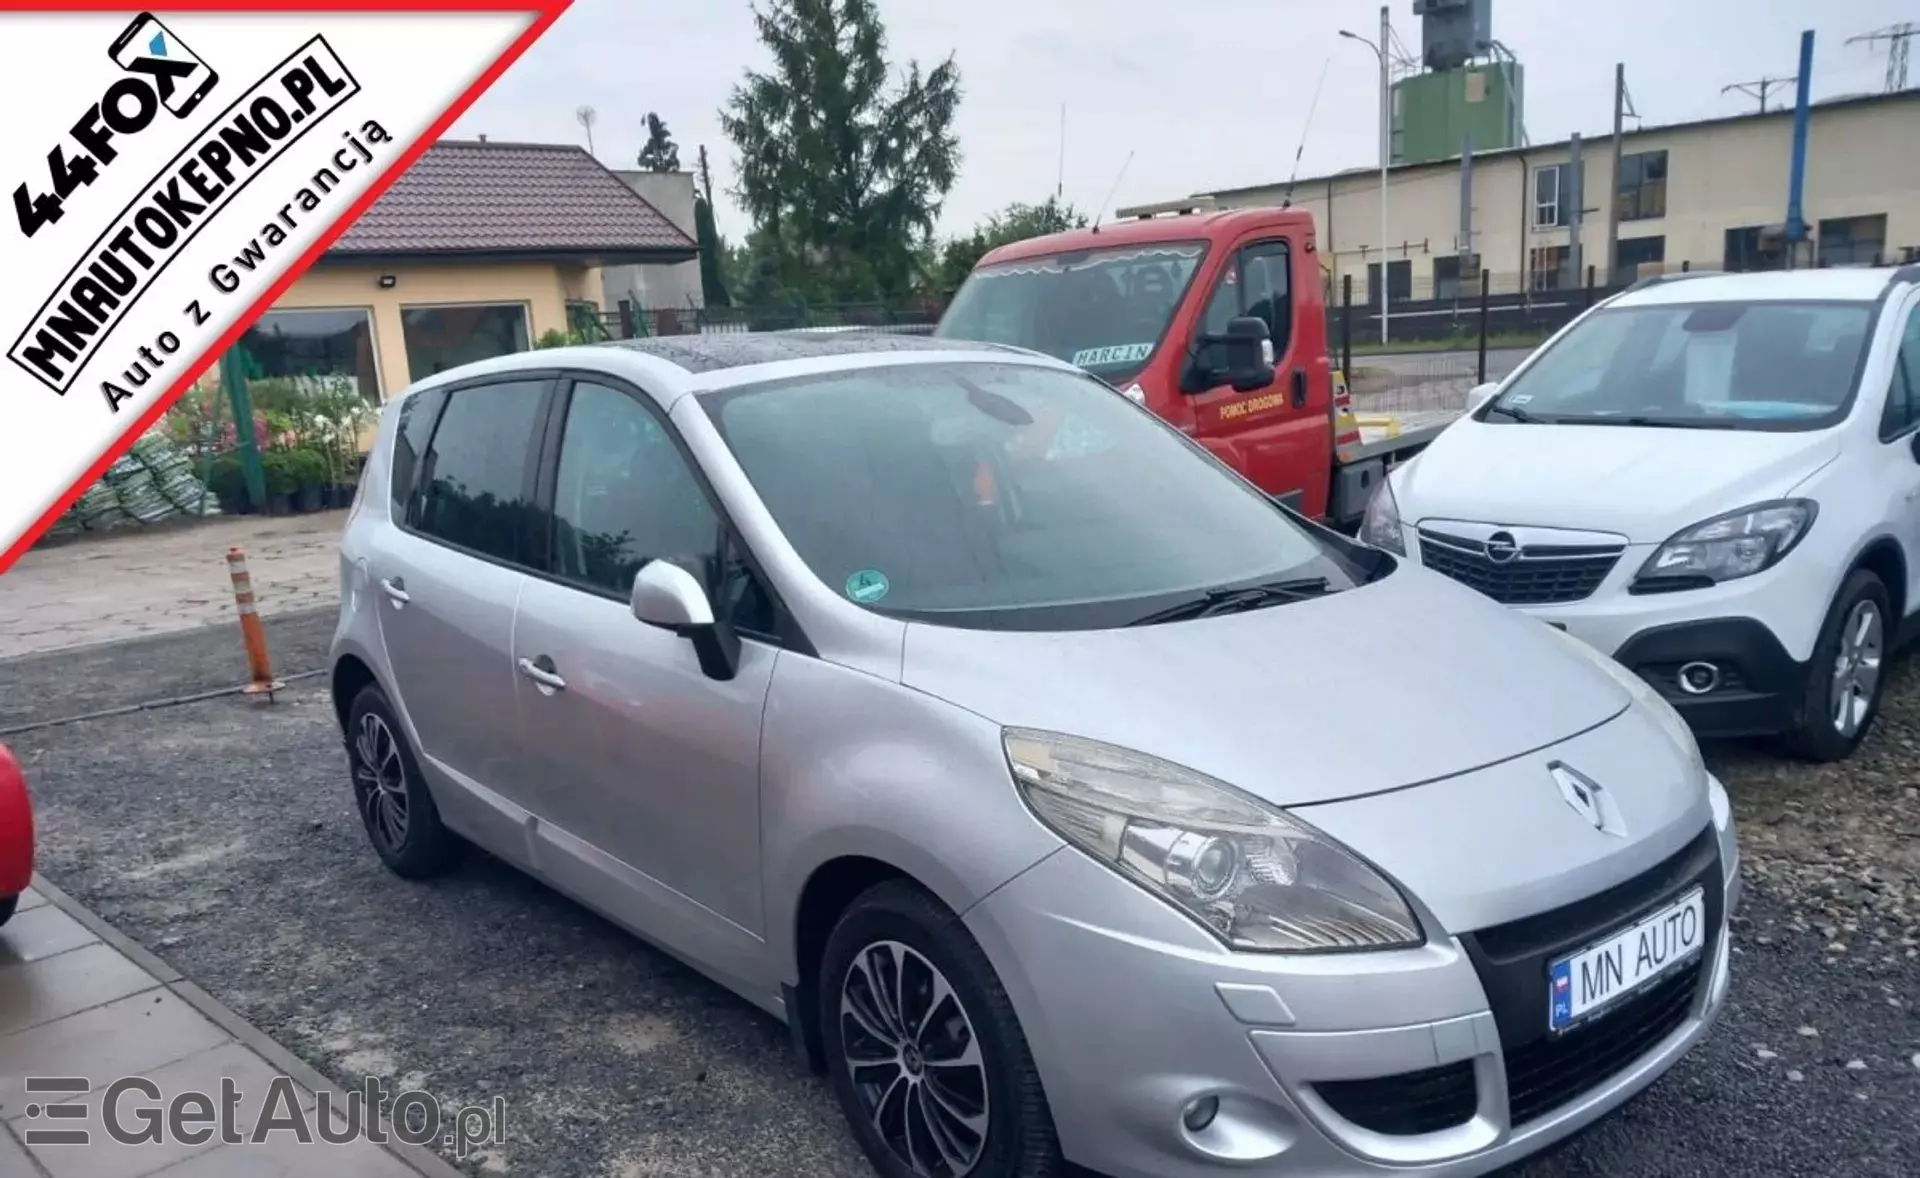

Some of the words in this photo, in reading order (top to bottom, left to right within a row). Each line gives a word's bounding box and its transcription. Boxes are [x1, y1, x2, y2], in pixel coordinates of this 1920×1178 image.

[1581, 943, 1624, 1005] MN
[1635, 905, 1697, 977] AUTO
[1555, 1003, 1569, 1018] PL
